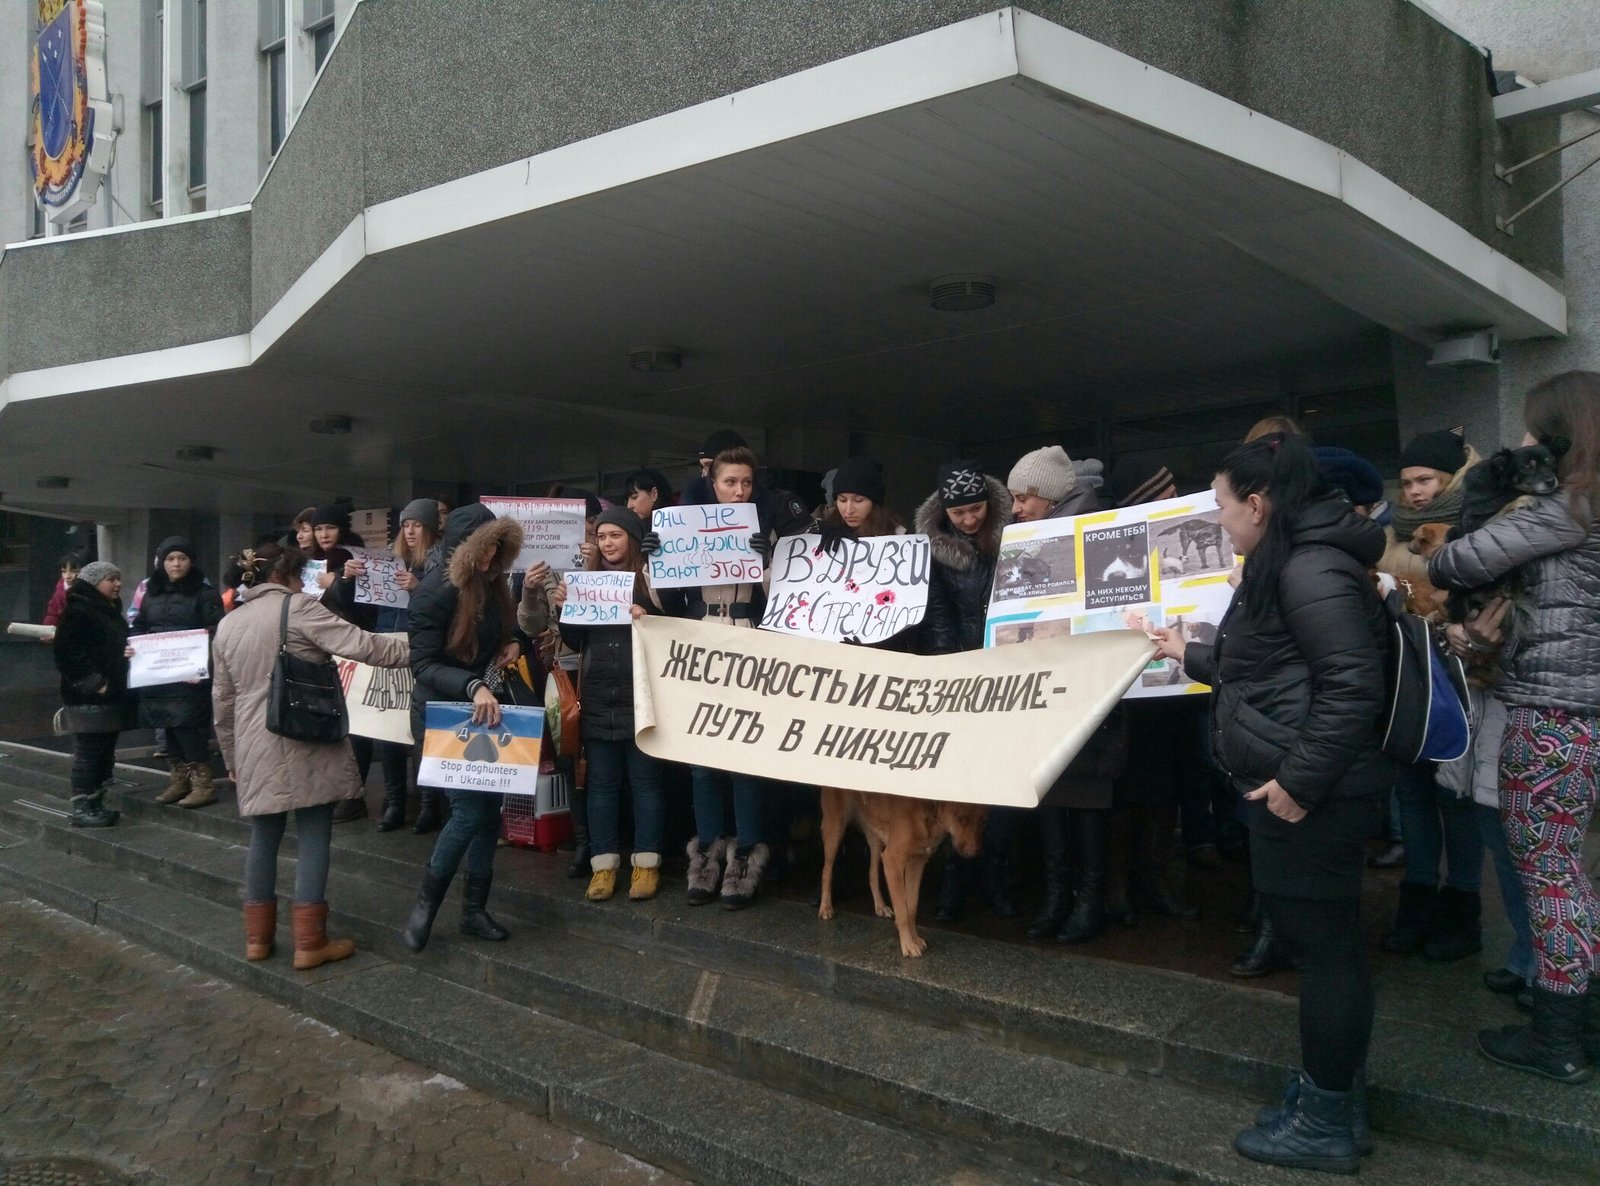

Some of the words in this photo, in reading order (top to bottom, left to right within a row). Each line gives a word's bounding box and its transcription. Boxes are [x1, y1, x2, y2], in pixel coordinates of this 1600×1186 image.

[1085, 529, 1121, 542] КРОМЕ
[1123, 524, 1147, 537] ТЕБЯ
[776, 537, 814, 583] В
[816, 538, 930, 586] ДРУЗЕЙ
[1048, 579, 1075, 588] РОДИЛСЯ
[1086, 589, 1096, 598] ЗА
[1097, 587, 1114, 595] НИХ
[1115, 584, 1148, 594] НЕКОМУ
[1090, 593, 1145, 605] ЗАСТУПИТЬСЯ
[660, 639, 849, 704] ЖЕСТОКОСТЬ
[848, 672, 881, 709] И
[687, 702, 765, 744] ПУТЬ
[778, 718, 806, 752] В
[813, 724, 951, 771] НИКУДА
[440, 760, 463, 774] Stop
[465, 762, 518, 776] doghunters
[444, 773, 454, 783] in
[460, 774, 496, 787] Ukraine
[499, 778, 511, 788] !!!
